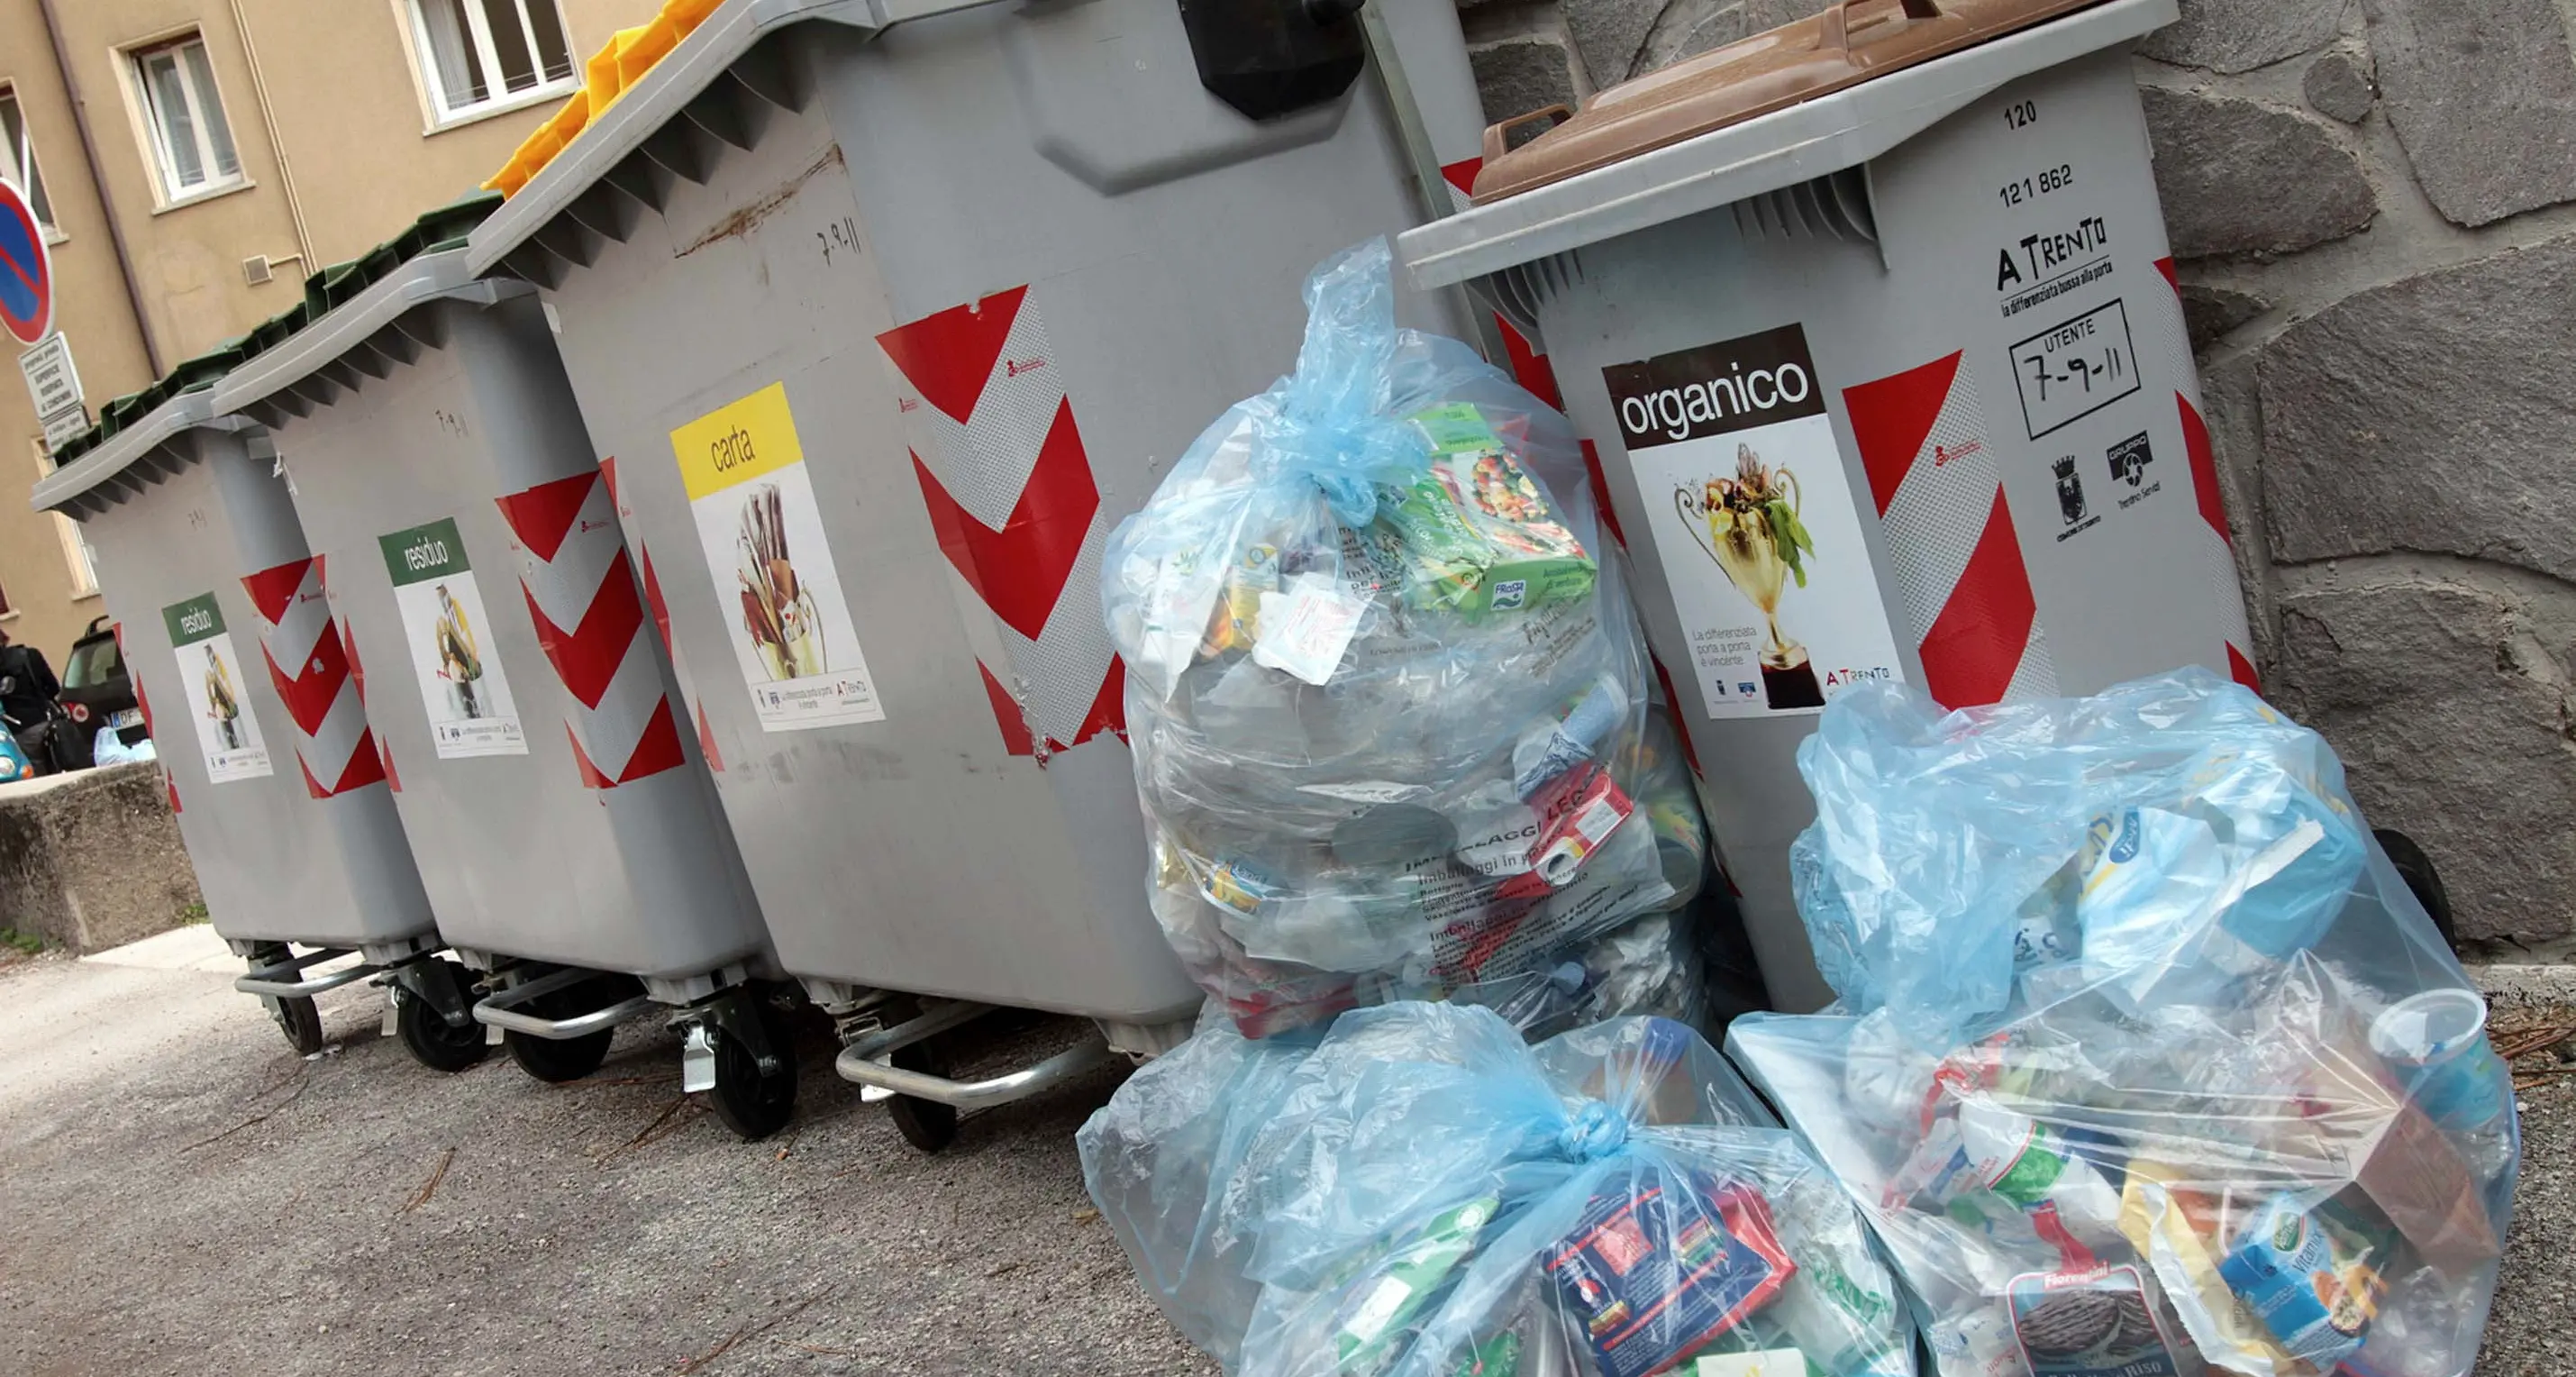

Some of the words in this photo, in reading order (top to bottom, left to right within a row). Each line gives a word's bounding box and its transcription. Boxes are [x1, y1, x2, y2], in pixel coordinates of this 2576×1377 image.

[2005, 99, 2036, 132] 120
[1999, 175, 2034, 209] 121
[2038, 163, 2073, 194] 862
[1998, 248, 2022, 291] A
[2019, 216, 2107, 280] TRENTO
[2044, 318, 2096, 354] UTENTE
[1622, 361, 1809, 441] organico
[711, 424, 756, 473] carta
[405, 536, 449, 570] residuo
[180, 606, 212, 635] residuo
[1826, 671, 1840, 686] A
[2044, 1261, 2109, 1288] Fiorentini
